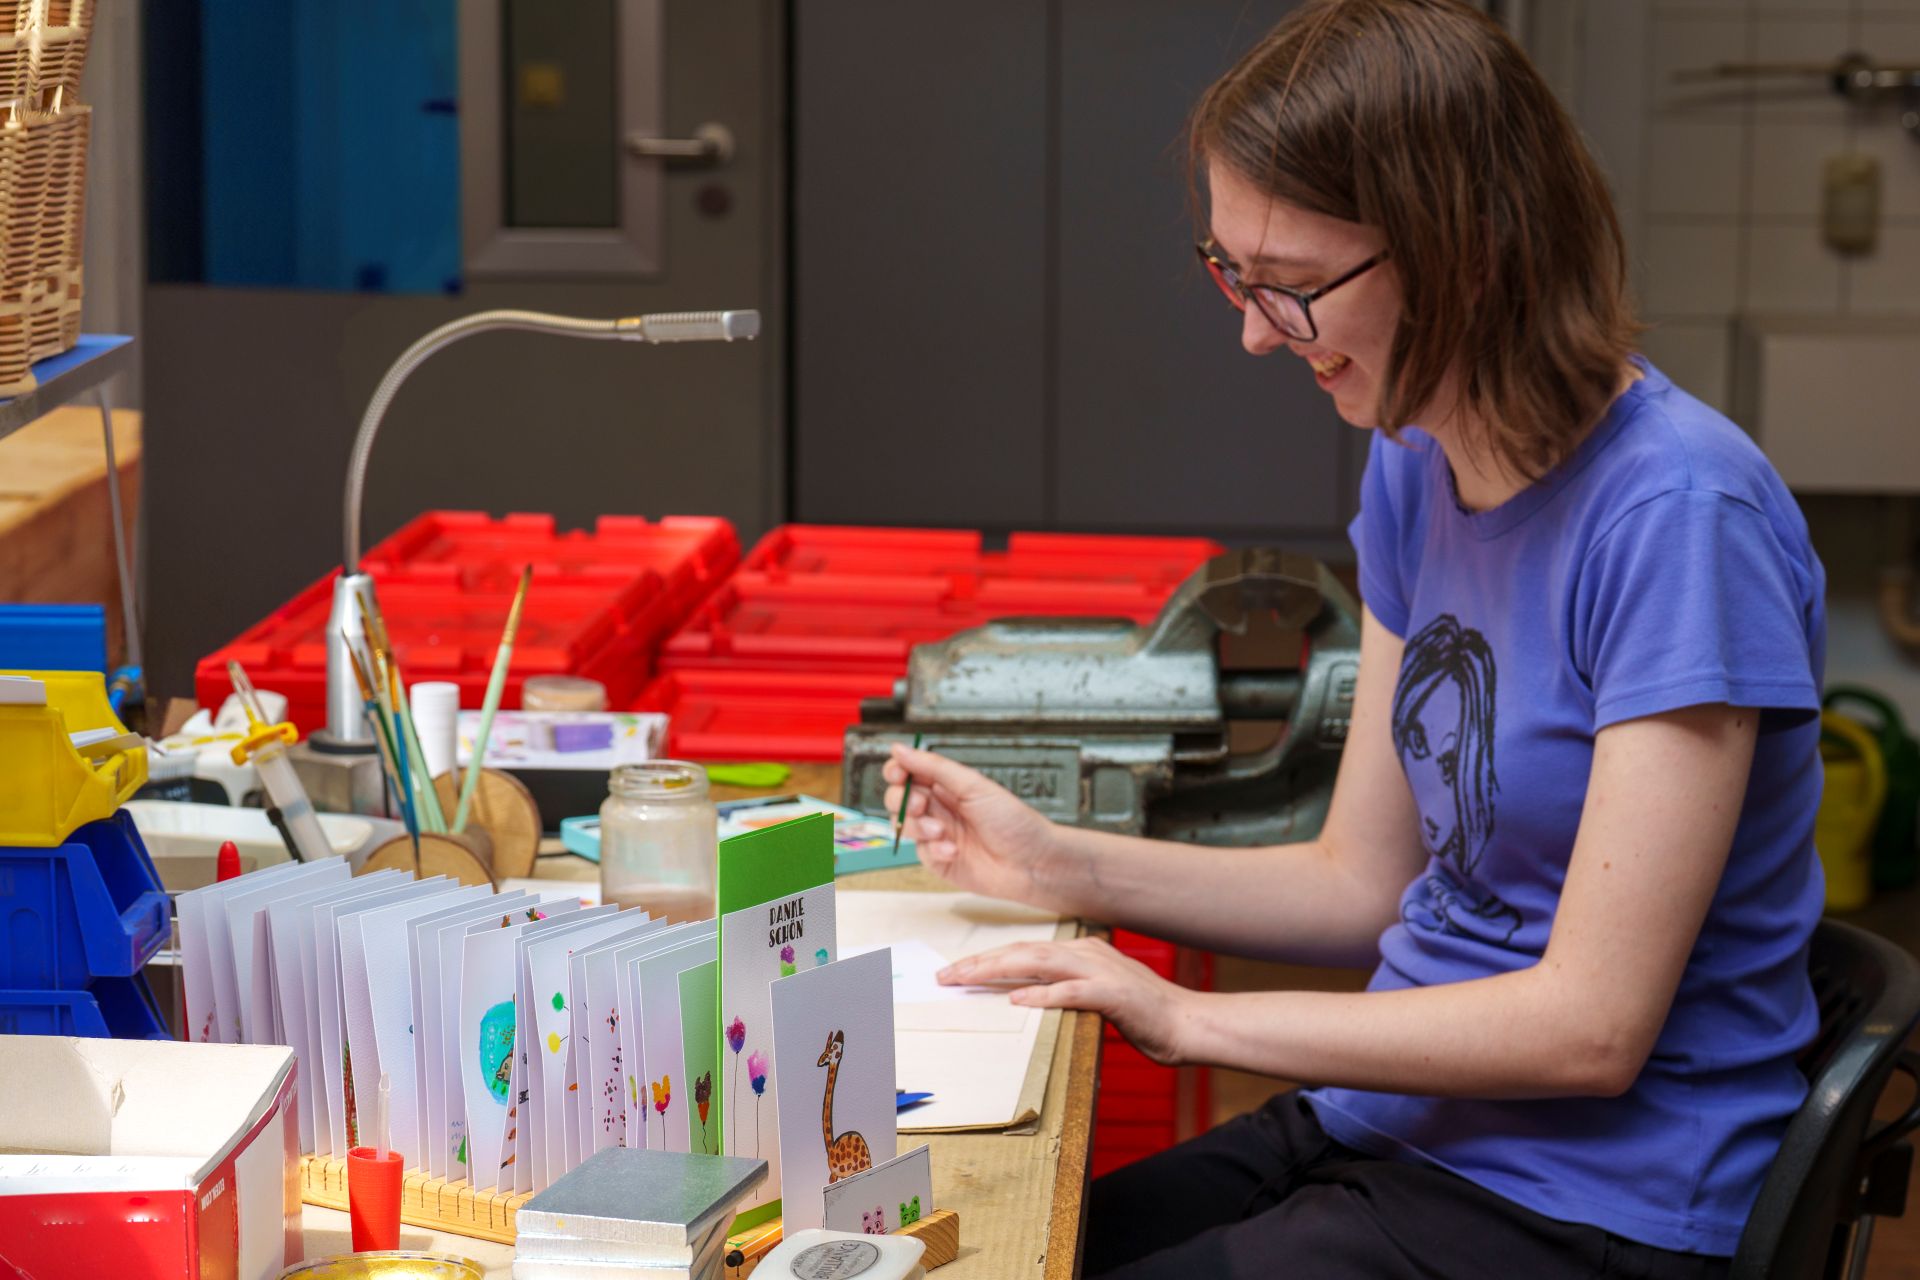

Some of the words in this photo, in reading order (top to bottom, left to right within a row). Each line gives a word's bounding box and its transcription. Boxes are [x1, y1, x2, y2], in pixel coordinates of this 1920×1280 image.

[769, 896, 805, 926] DANKE
[769, 919, 804, 948] SCHÖN
[812, 1242, 861, 1280] BRILLIANCE
